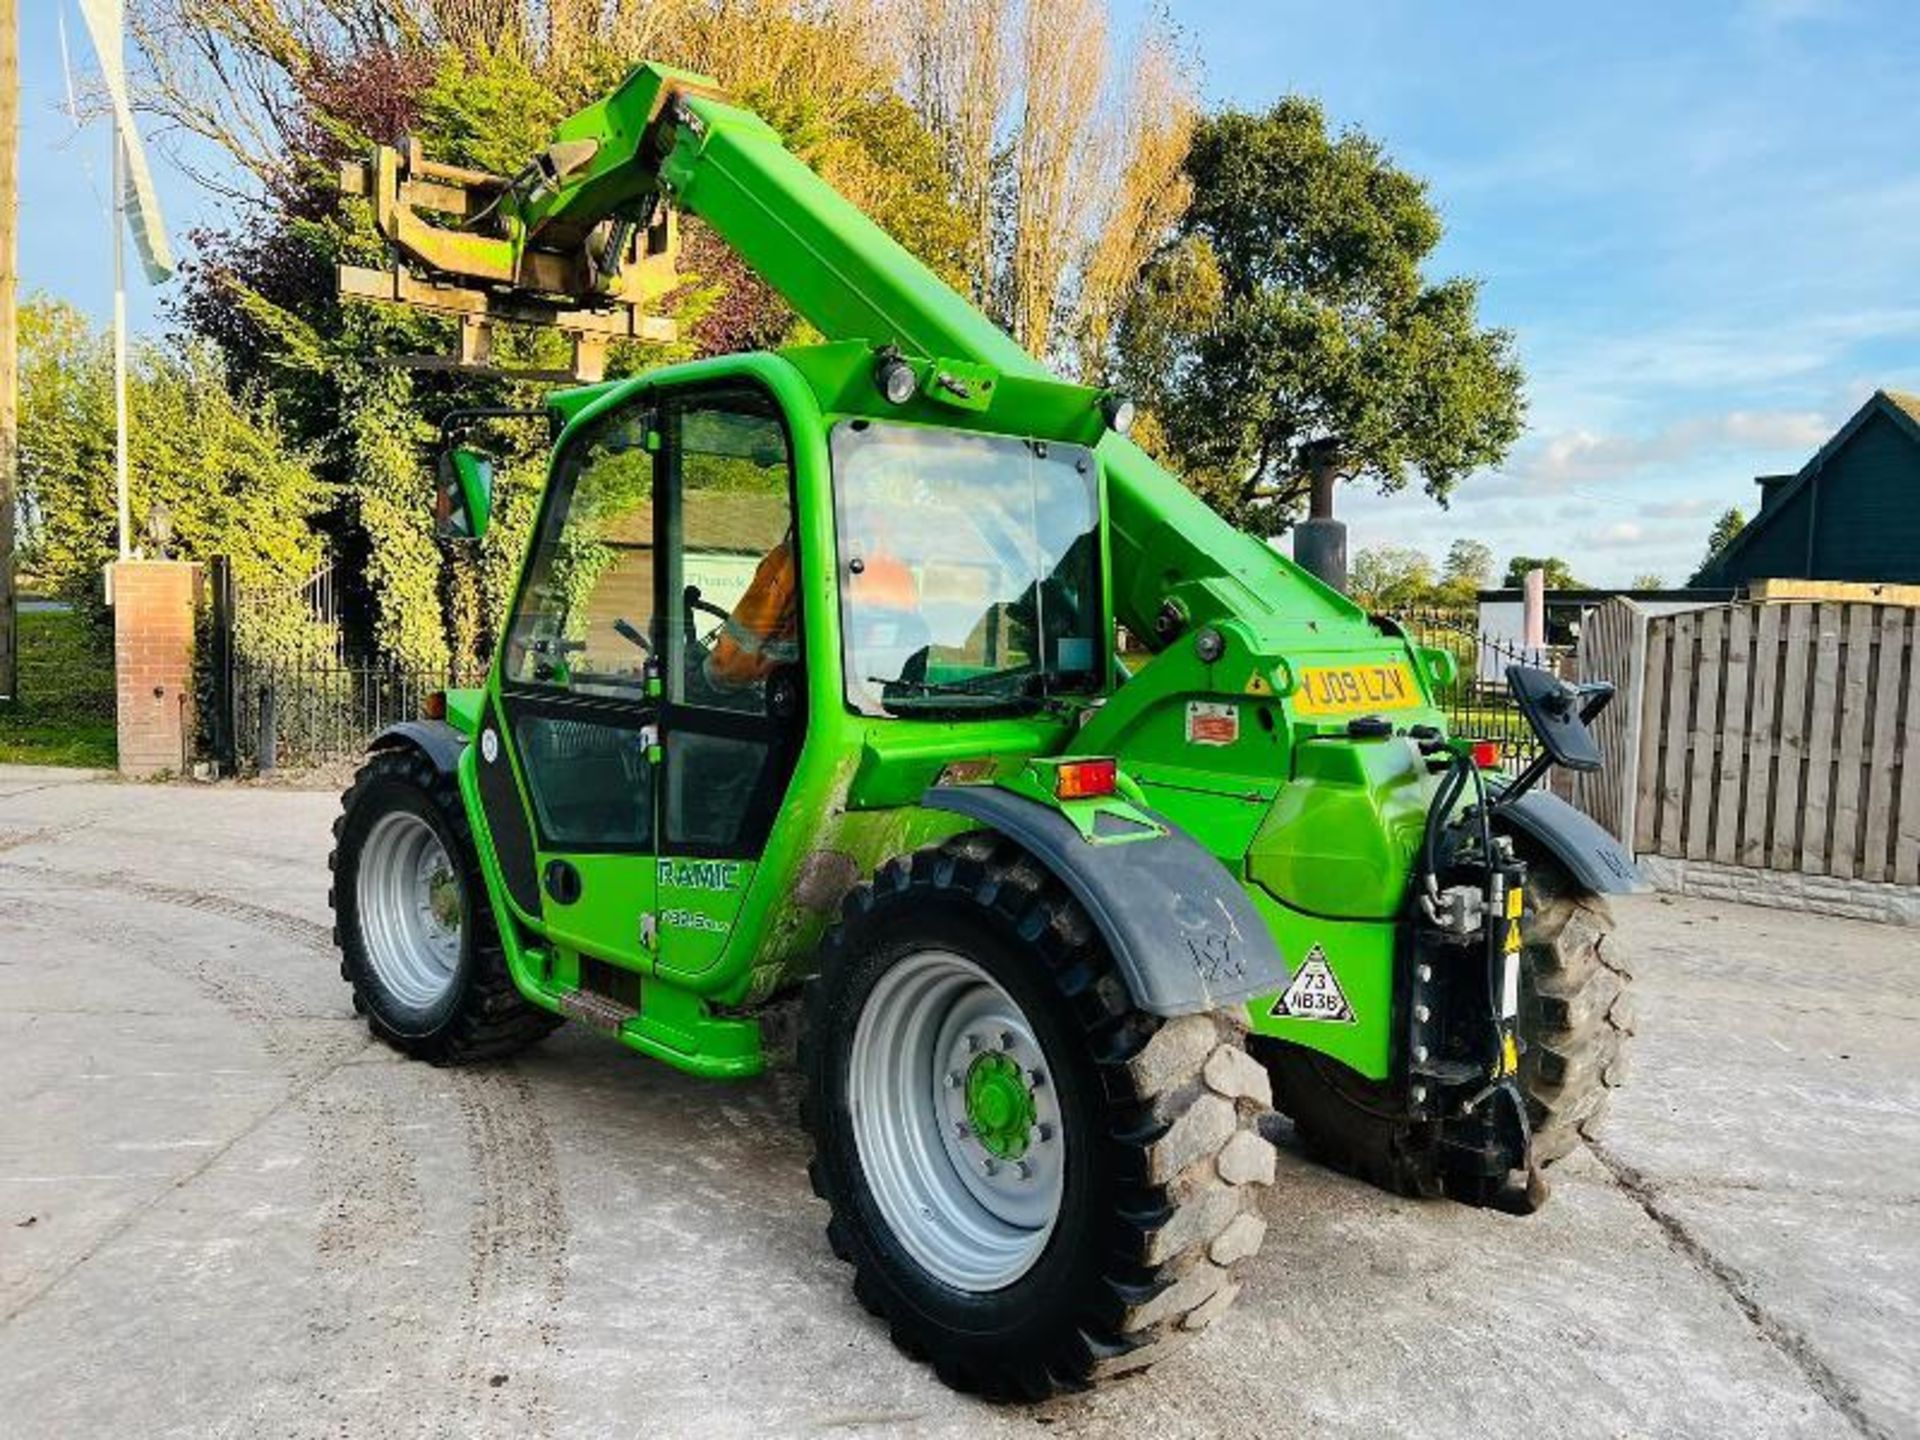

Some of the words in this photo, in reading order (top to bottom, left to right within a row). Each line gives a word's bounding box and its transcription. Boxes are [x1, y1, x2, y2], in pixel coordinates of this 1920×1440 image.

[1302, 671, 1362, 704] YJ09
[1360, 669, 1405, 701] LZV
[1304, 973, 1326, 990] 73
